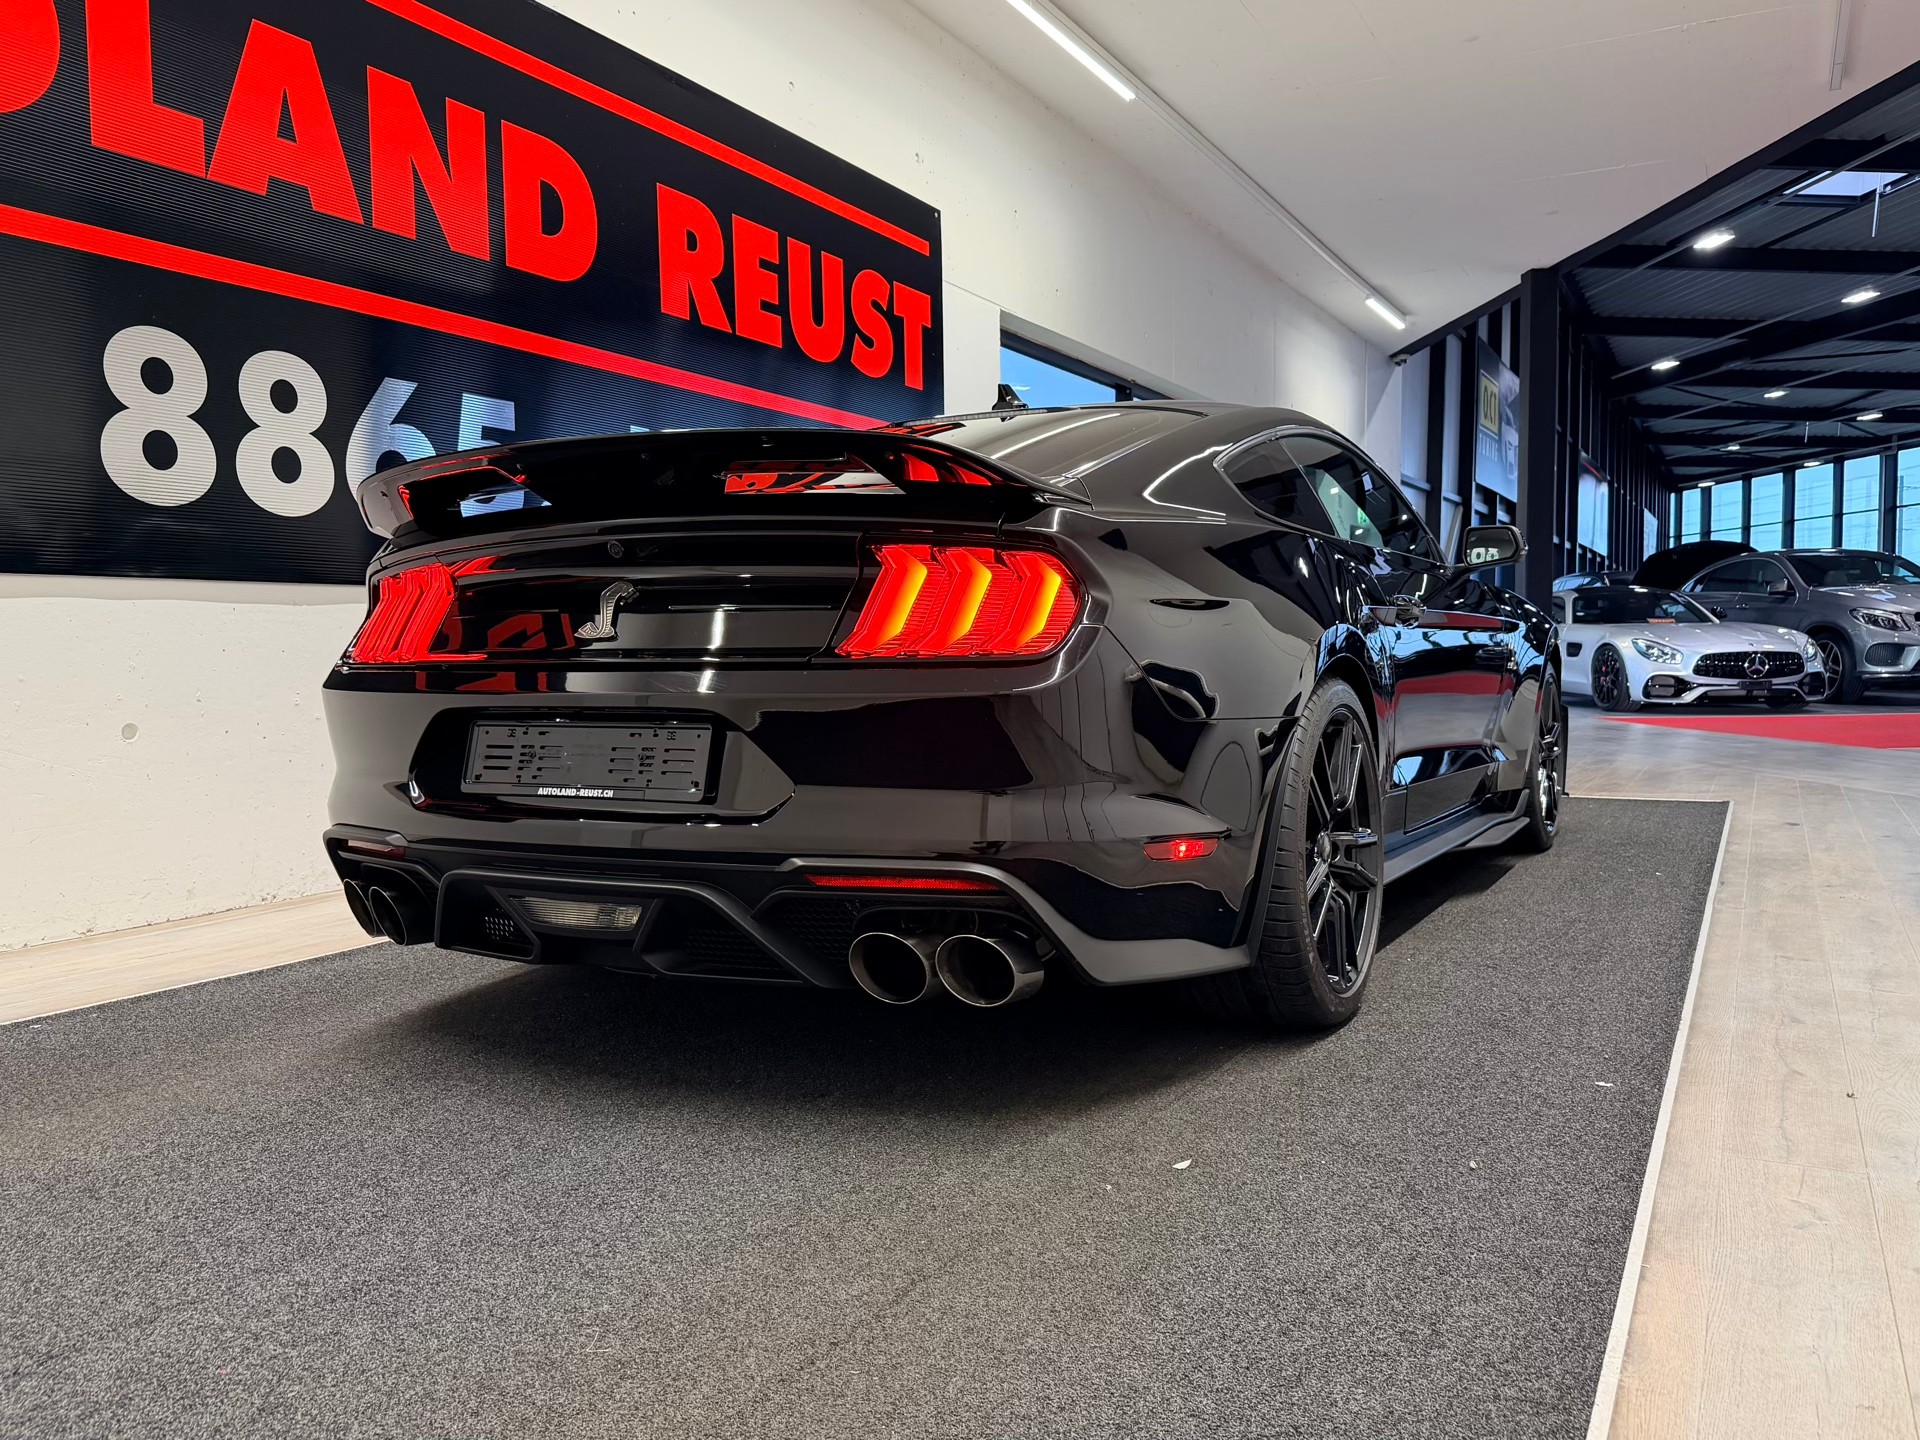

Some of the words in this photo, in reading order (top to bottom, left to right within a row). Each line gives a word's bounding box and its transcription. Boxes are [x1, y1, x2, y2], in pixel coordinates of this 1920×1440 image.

[0, 0, 598, 282] LAND
[657, 183, 931, 390] REUST
[537, 787, 614, 798] AUTOLAND-REUST.CH
